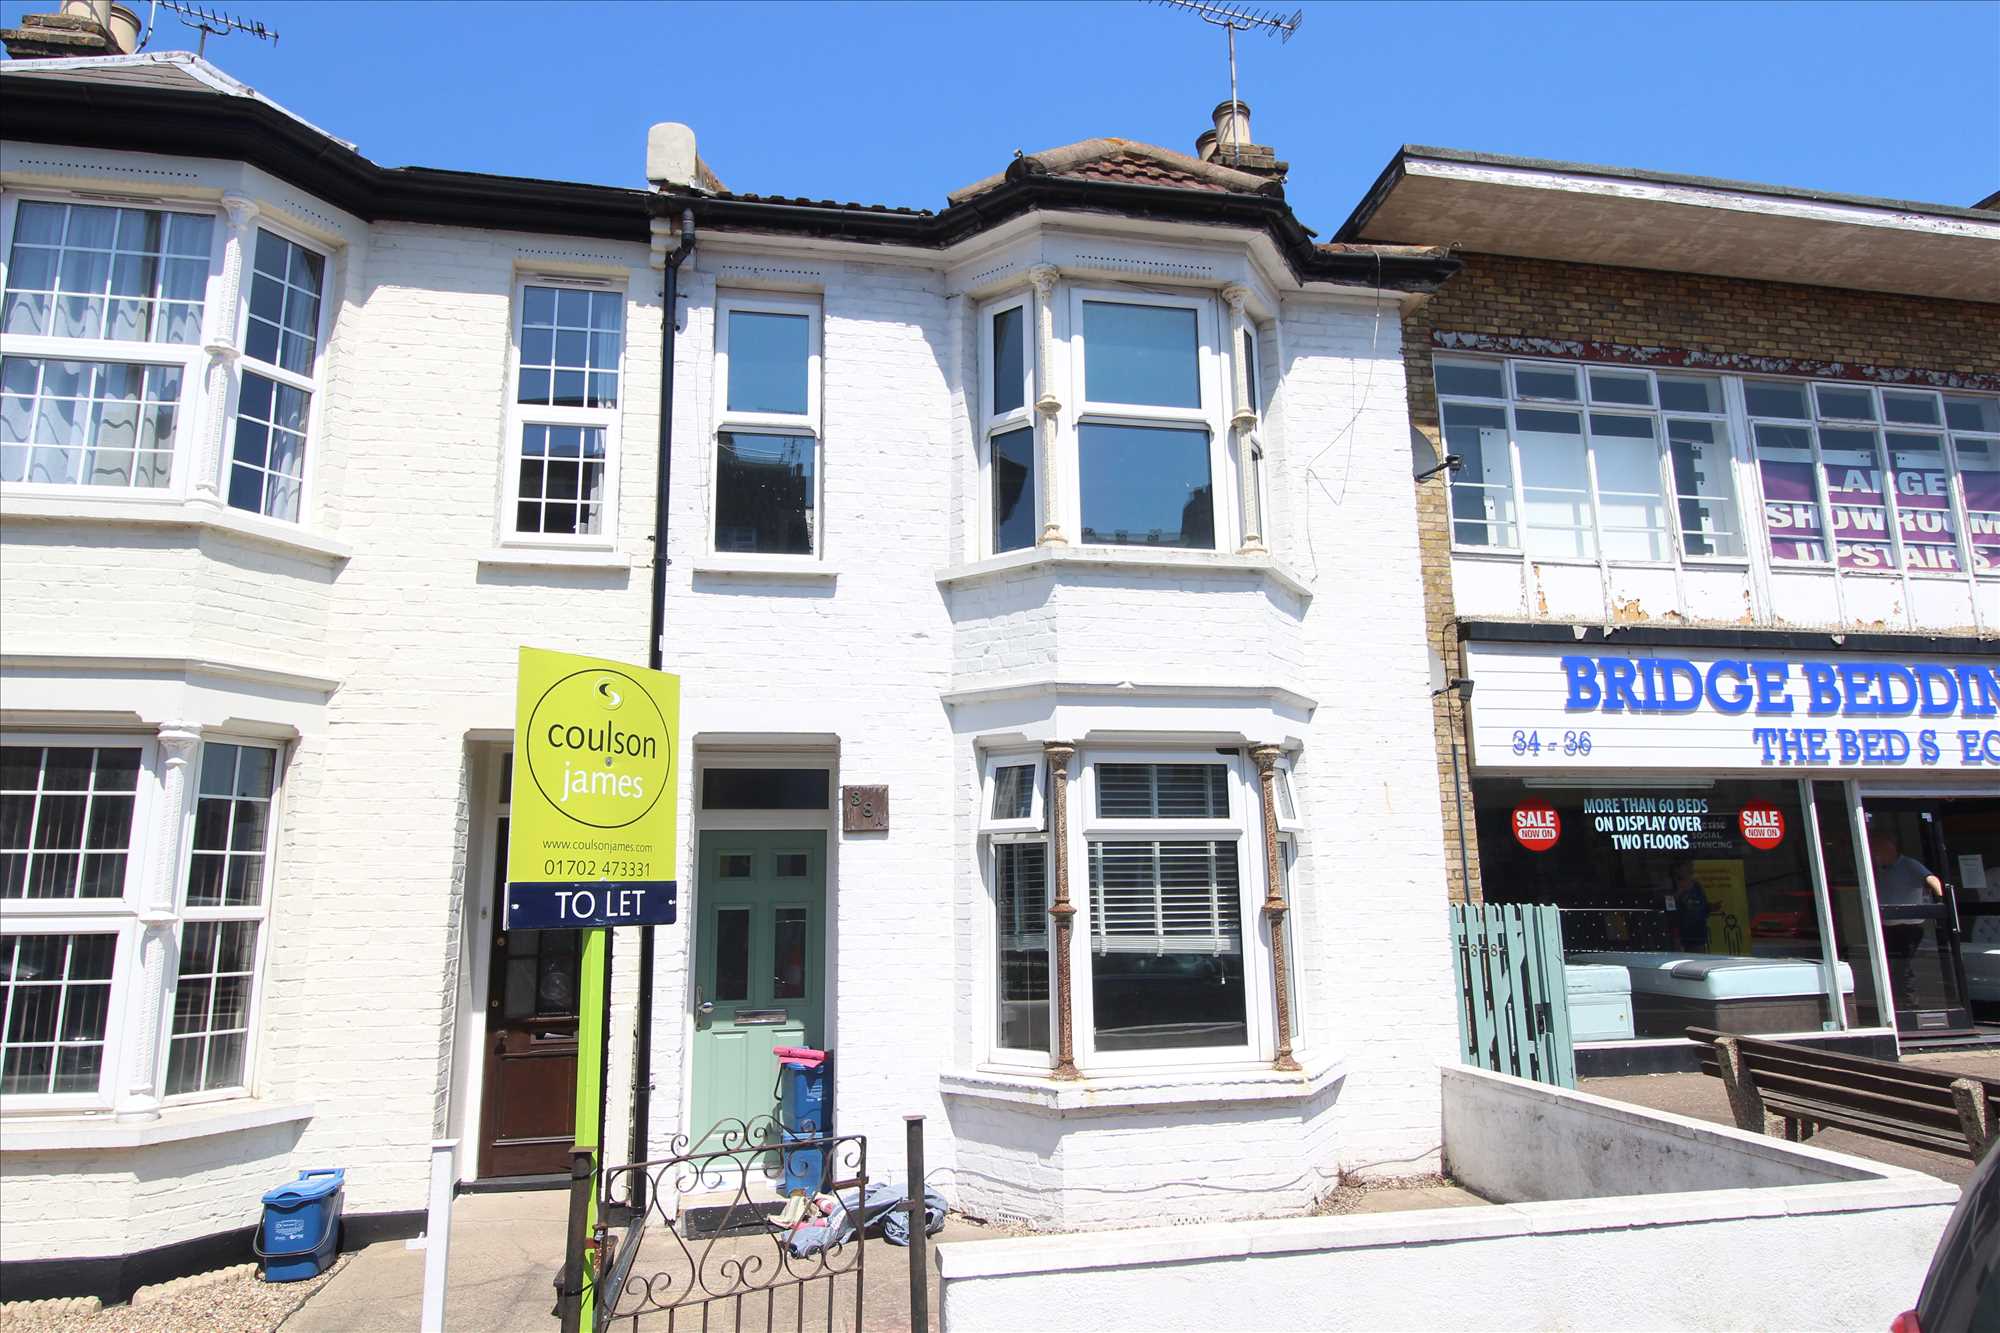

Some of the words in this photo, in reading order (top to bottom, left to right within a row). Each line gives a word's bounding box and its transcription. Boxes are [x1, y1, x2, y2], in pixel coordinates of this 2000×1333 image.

[1826, 470, 1948, 496] AGE
[1561, 656, 1794, 715] BRIDGE
[547, 719, 656, 759] coulson
[1512, 730, 1541, 756] 34
[1563, 730, 1592, 756] 36
[1753, 728, 1830, 764] THE
[560, 760, 644, 802] james
[1584, 798, 1620, 813] MORE
[1624, 798, 1656, 813] THAN
[1659, 799, 1674, 813] 60
[1677, 799, 1709, 813] BEDS
[1516, 810, 1556, 827] SALE
[1595, 816, 1613, 832] ON
[1616, 815, 1666, 831] DISPLAY
[1669, 816, 1702, 831] OVER
[1743, 810, 1779, 826] SALE
[1521, 829, 1540, 838] NOW
[1541, 829, 1553, 838] ON
[1748, 828, 1765, 837] NOW
[1766, 828, 1778, 837] ON
[542, 839, 653, 854] www.coulsonjames.com
[1611, 834, 1641, 850] TWO
[1643, 834, 1690, 850] FLOORS
[544, 859, 596, 875] 01702
[601, 861, 651, 877] 473331
[554, 890, 596, 919] TO
[606, 889, 646, 917] LET
